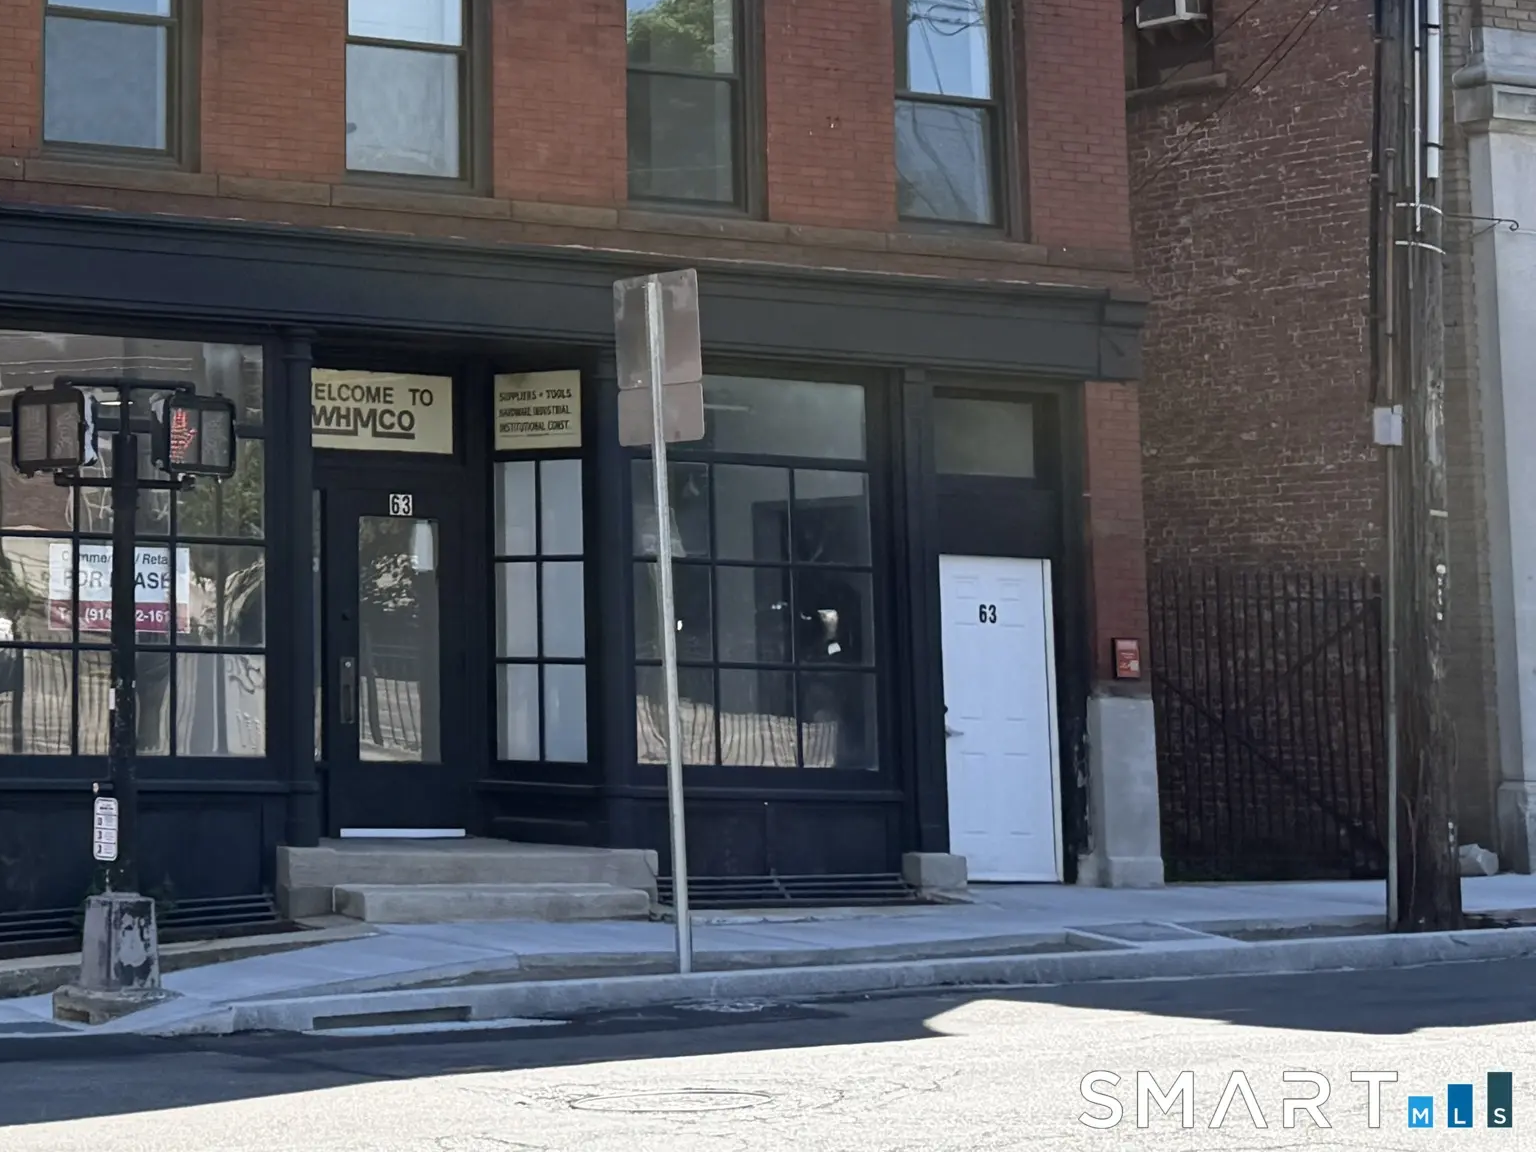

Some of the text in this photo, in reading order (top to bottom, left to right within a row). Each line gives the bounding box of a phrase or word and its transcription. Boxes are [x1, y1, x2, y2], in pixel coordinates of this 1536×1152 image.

[311, 382, 433, 406] ELCOME TO
[311, 404, 415, 434] WHMCO
[391, 495, 412, 515] 63
[142, 553, 169, 565] Reta
[979, 604, 997, 624] 63
